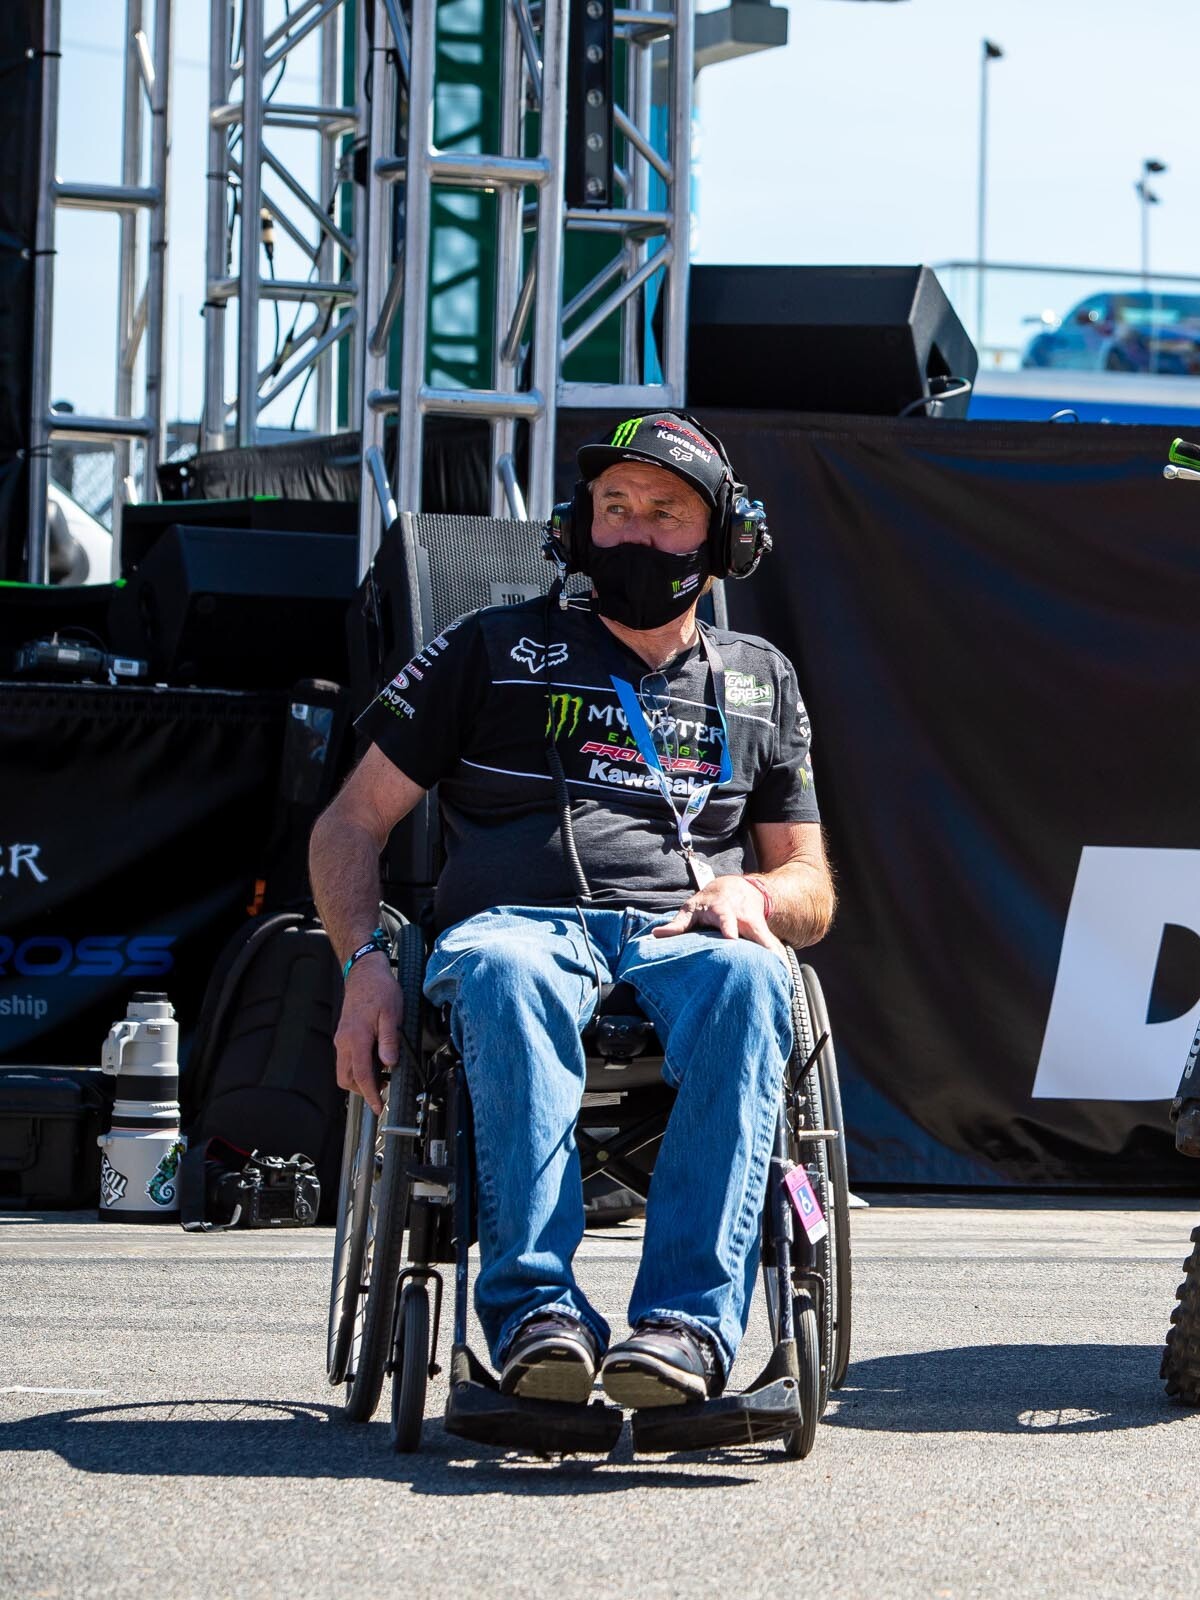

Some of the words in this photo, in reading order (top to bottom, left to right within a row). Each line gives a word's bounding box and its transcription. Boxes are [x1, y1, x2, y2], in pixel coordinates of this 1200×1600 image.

[656, 429, 712, 464] Kawasaki
[723, 672, 754, 688] TEAM
[727, 682, 770, 701] GREEN
[579, 740, 638, 761] PRO
[607, 731, 709, 759] ENRGY
